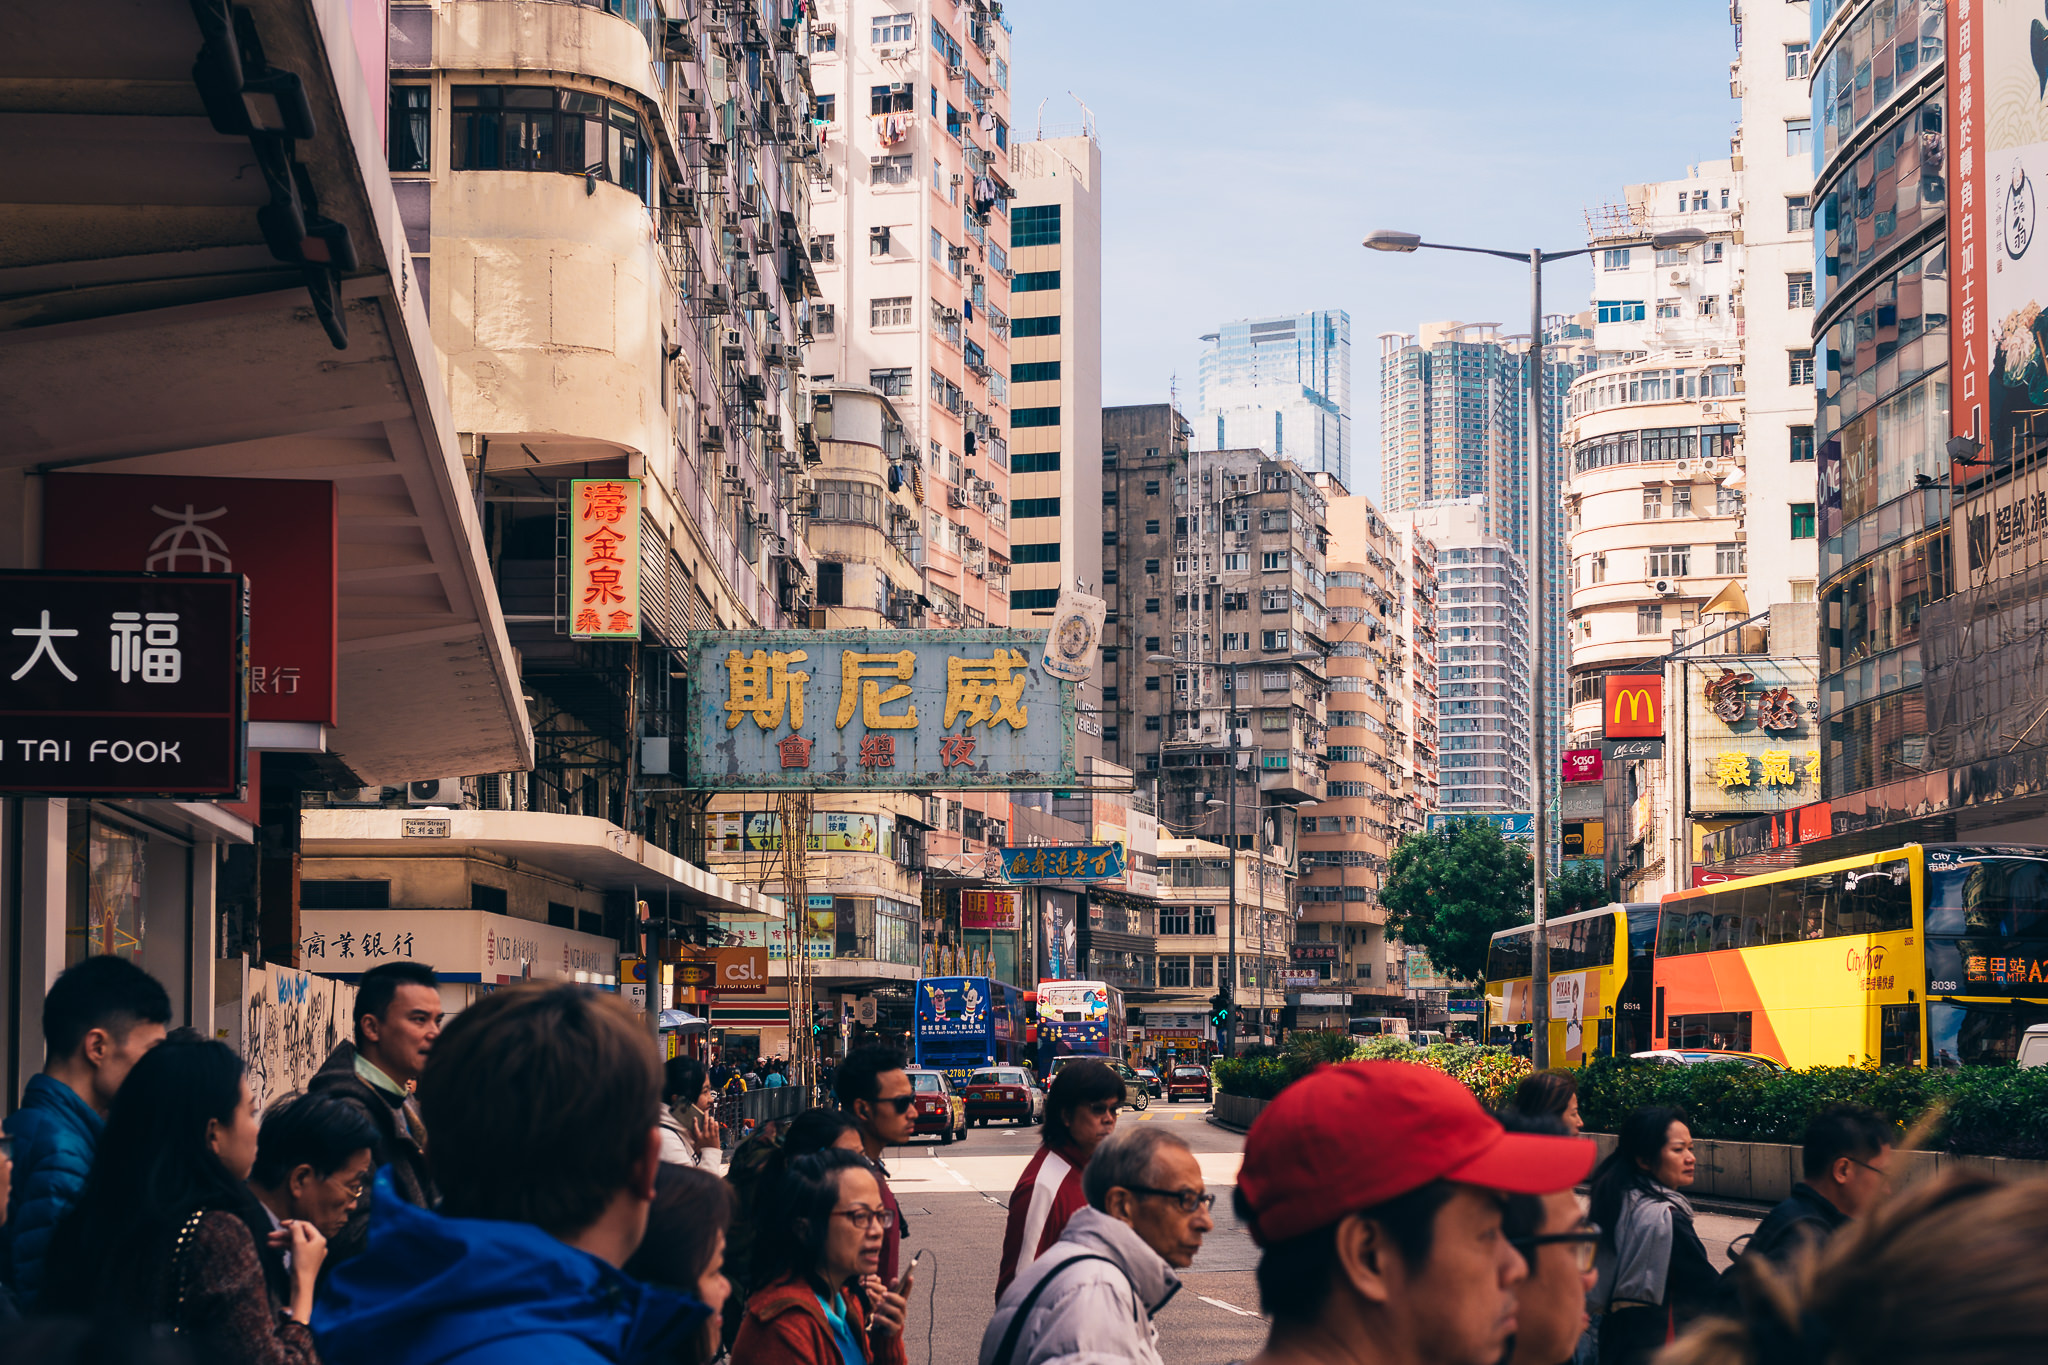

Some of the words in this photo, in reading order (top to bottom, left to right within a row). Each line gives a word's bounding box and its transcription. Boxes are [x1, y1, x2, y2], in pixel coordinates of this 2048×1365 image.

[582, 481, 628, 605] 濤金泉
[576, 608, 633, 633] 桑拿
[11, 609, 182, 684] 大福
[17, 739, 71, 762] TAI
[89, 740, 182, 763] FOOK
[1928, 862, 1958, 871] 市中心
[1932, 852, 1951, 861] City
[967, 893, 1014, 914] 明珠
[302, 931, 415, 959] 商業銀行
[496, 935, 511, 961] NCB
[1931, 981, 1957, 990] 8036
[1968, 974, 1987, 982] Lam
[1992, 973, 2004, 982] Tin
[2007, 974, 2027, 983] MTR
[1556, 981, 1571, 997] PIXAR
[950, 1069, 966, 1078] 2780
